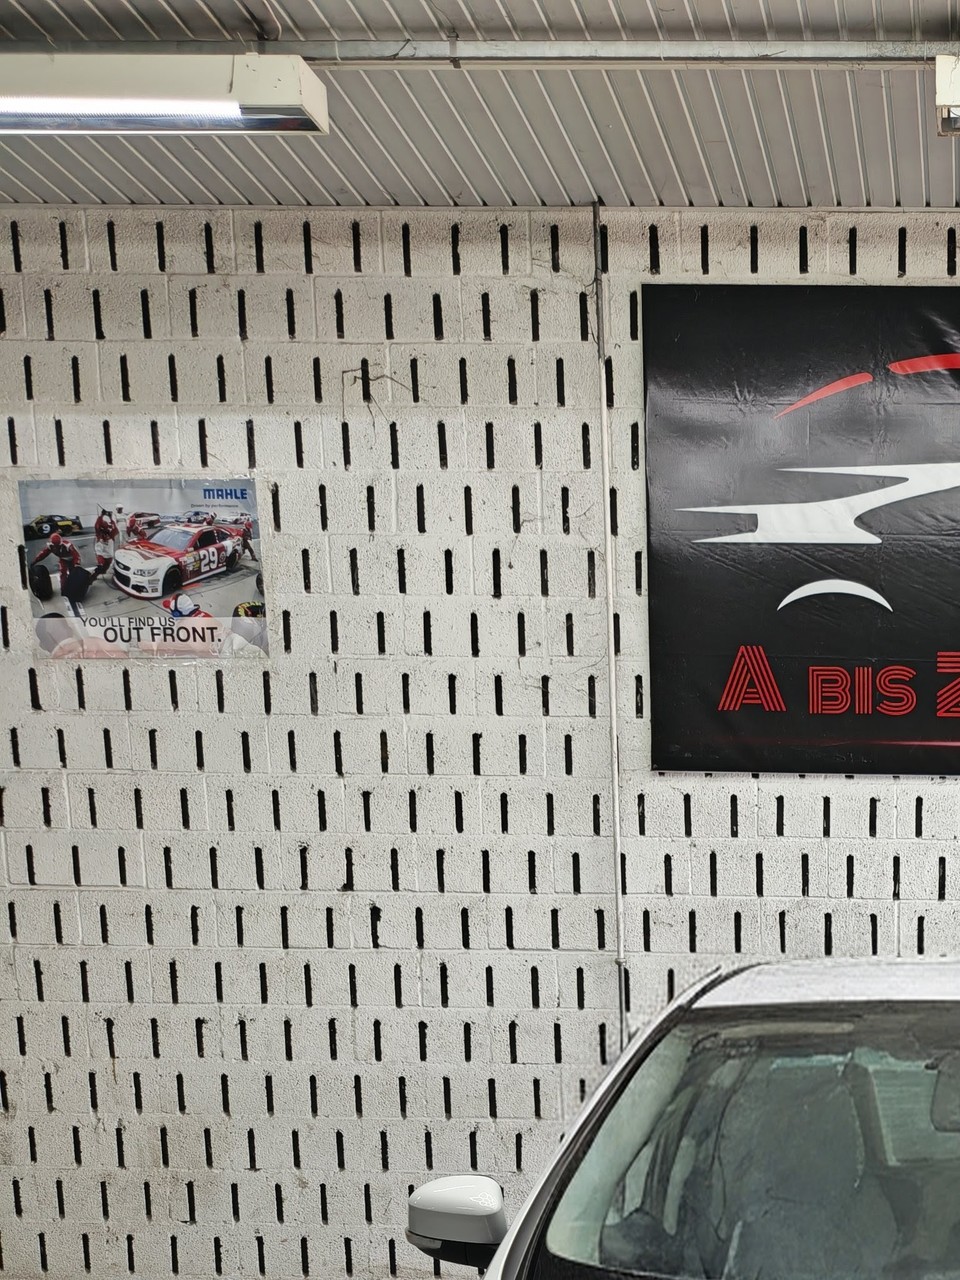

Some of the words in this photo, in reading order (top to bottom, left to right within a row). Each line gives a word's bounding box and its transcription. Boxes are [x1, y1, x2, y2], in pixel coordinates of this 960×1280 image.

[203, 488, 248, 500] MAHLE
[42, 523, 50, 534] 9
[200, 547, 218, 573] 29
[80, 617, 125, 627] YOU'LL
[128, 616, 155, 627] FIND
[159, 616, 176, 627] US
[103, 626, 143, 643] OUT
[150, 626, 222, 643] FRONT.
[717, 645, 787, 712] A
